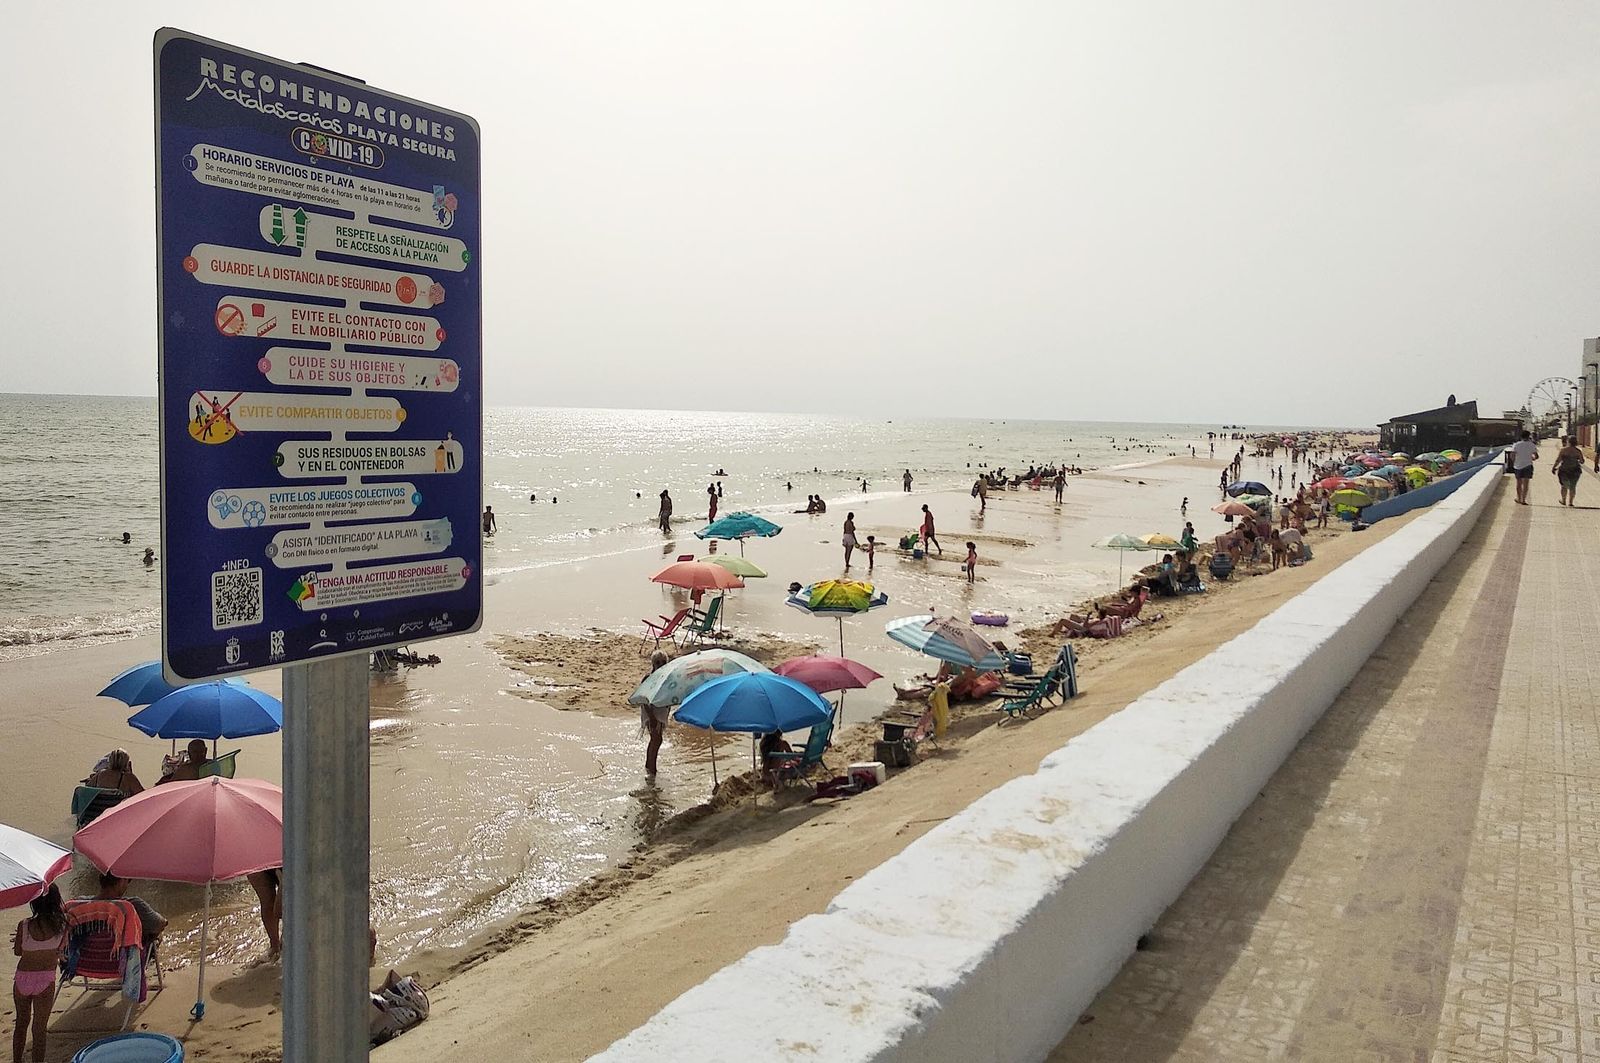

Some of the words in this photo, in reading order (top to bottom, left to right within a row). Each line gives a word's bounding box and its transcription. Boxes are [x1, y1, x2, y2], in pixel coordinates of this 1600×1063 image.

[200, 57, 455, 142] RECOMENDACIONES
[348, 122, 398, 147] PLAYA
[402, 138, 456, 161] SEGURA
[203, 148, 252, 167] HORARIO
[255, 160, 308, 180] SERVICIOS
[310, 172, 323, 182] DE
[326, 174, 354, 188] PLAYA
[377, 186, 384, 194] 11
[406, 194, 420, 203] horas
[205, 162, 214, 172] Se
[216, 166, 256, 180] recomienda
[268, 176, 304, 189] permanecer
[306, 181, 320, 192] más
[321, 186, 330, 194] de
[336, 189, 352, 200] horas
[370, 196, 385, 207] playa
[205, 174, 232, 184] mañana
[240, 180, 257, 190] tarde
[258, 184, 272, 193] para
[274, 186, 291, 196] evitar
[336, 226, 376, 241] RESPETE
[378, 232, 388, 243] LA
[390, 236, 448, 254] SEÑALIZACIÓN
[336, 238, 348, 248] DE
[350, 240, 390, 255] ACCESOS
[392, 246, 398, 256] A
[400, 248, 411, 258] LA
[413, 250, 438, 262] PLAYA
[210, 260, 254, 276] GUARDE
[258, 266, 270, 278] LA
[273, 268, 324, 285] DISTANCIA
[328, 275, 340, 286] DE
[342, 277, 392, 293] SEGURIDAD
[292, 309, 324, 322] EVITE
[328, 313, 341, 324] EL
[346, 315, 402, 330] CONTACTO
[405, 321, 426, 332] CON
[292, 324, 305, 334] EL
[310, 326, 376, 340] MOBILIARIO
[380, 330, 424, 344] PÚBLICO
[288, 356, 326, 368] CUIDE
[330, 360, 346, 368] SU
[350, 360, 394, 372] HIGIENE
[398, 362, 405, 373] Y
[289, 370, 304, 380] LA
[309, 370, 324, 380] DE
[328, 371, 352, 382] SUS
[356, 372, 406, 384] OBJETOS
[240, 406, 272, 418] EVITE
[276, 406, 342, 419] COMPARTIR
[345, 408, 392, 420] OBJETOS
[298, 448, 320, 459] SUS
[322, 447, 372, 458] RESIDUOS
[376, 447, 388, 458] EN
[390, 447, 426, 457] BOLSAS
[298, 461, 306, 472] Y
[308, 461, 322, 472] EN
[325, 460, 336, 472] EL
[340, 460, 404, 471] CONTENEDOR
[270, 492, 296, 503] EVITE
[298, 492, 316, 502] LOS
[318, 490, 352, 501] JUEGOS
[354, 488, 406, 500] COLECTIVOS
[279, 503, 314, 512] recomienda
[326, 500, 346, 508] realizar
[288, 511, 314, 519] contacto
[282, 537, 312, 548] ASISTA
[377, 530, 384, 540] A
[384, 530, 394, 540] LA
[395, 528, 418, 539] PLAYA
[338, 545, 360, 553] formato
[222, 558, 250, 570] +INFO
[318, 576, 344, 588] TENGA
[346, 574, 363, 585] UNA
[365, 570, 396, 582] ACTITUD
[398, 564, 448, 578] RESPONSABLE
